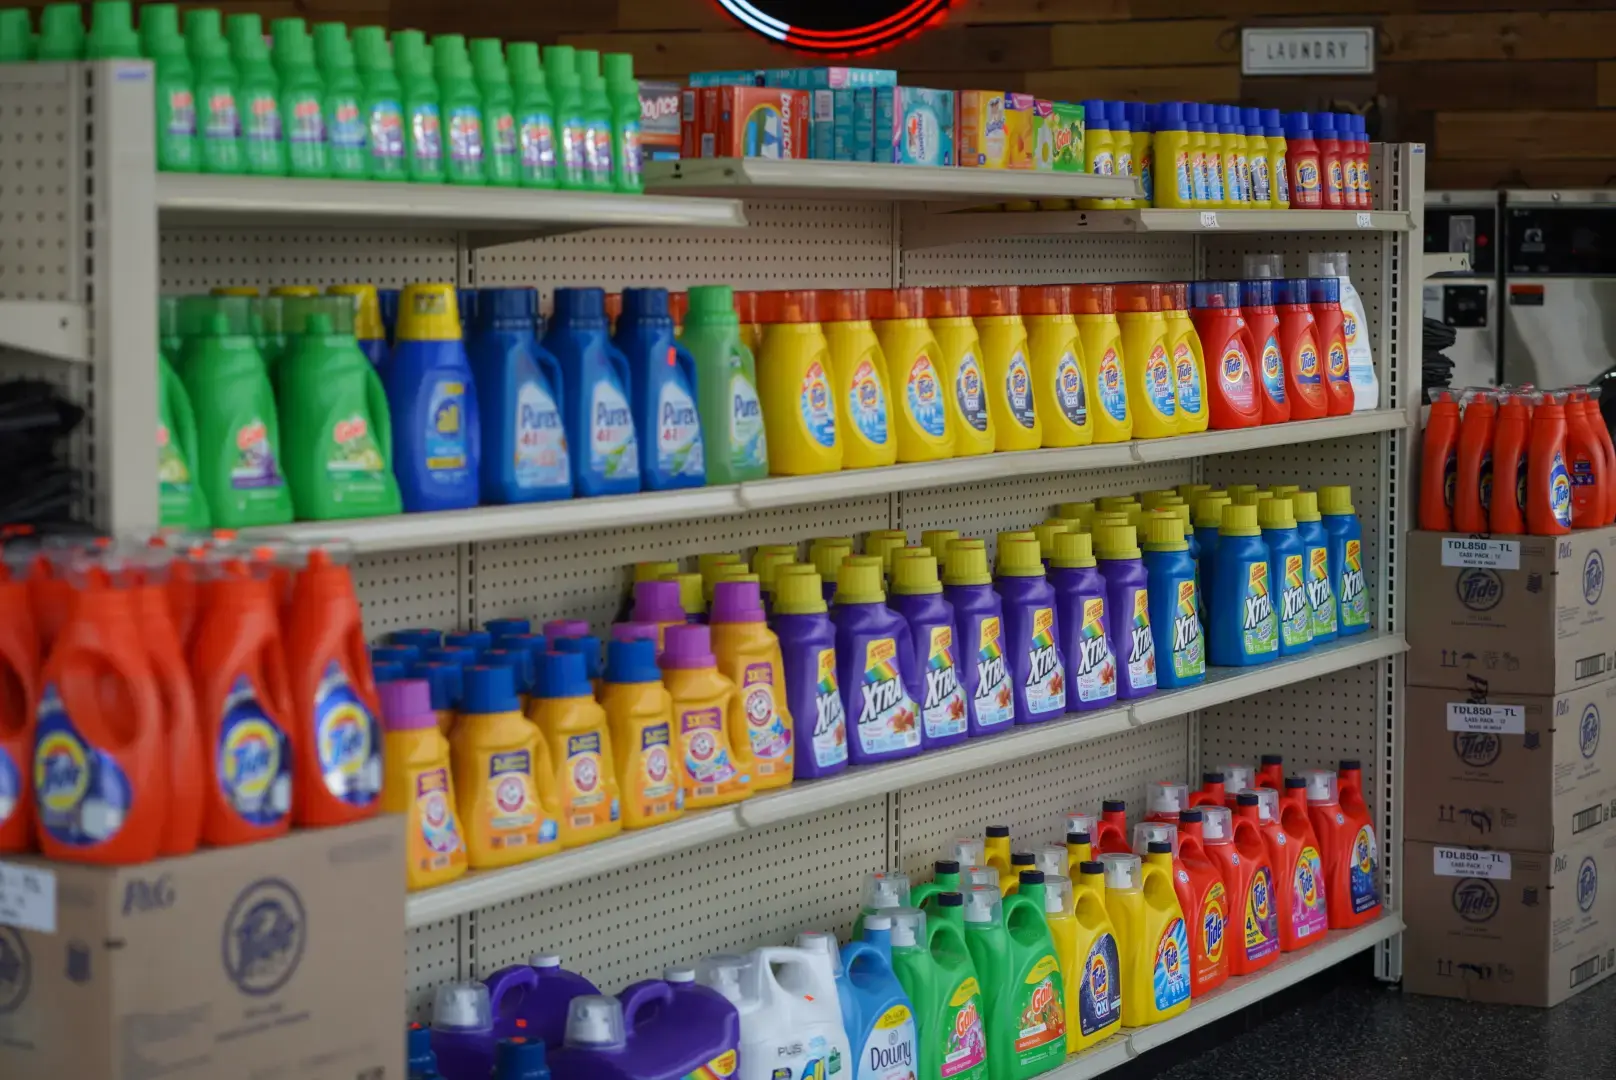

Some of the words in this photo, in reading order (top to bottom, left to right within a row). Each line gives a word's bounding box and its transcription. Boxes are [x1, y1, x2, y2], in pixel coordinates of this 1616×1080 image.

[1266, 41, 1348, 60] LAUNDRY
[1299, 166, 1317, 184] Tide
[1177, 364, 1192, 381] Tide
[1224, 359, 1241, 377] Tide
[1265, 355, 1278, 373] Tide
[1300, 352, 1316, 371] Tide
[1329, 351, 1344, 370] Tide
[1063, 373, 1078, 391] Tide
[1105, 369, 1118, 387] Tide
[1154, 366, 1167, 383] Tide
[663, 401, 696, 426] Purex
[1552, 485, 1569, 510] Tide
[1448, 540, 1487, 551] TDL850
[1499, 543, 1512, 552] TL
[1463, 578, 1499, 602] Tide
[1244, 592, 1271, 630] XTRA
[1282, 583, 1307, 622] XTRA
[1026, 643, 1058, 687] XTRA
[1077, 632, 1108, 676] XTRA
[923, 664, 958, 711] XTRA
[858, 675, 904, 725] XTRA
[1453, 705, 1492, 716] TDL850
[1504, 708, 1517, 717] TL
[1357, 841, 1368, 863] Tide
[1439, 850, 1479, 861] TDL850
[1491, 853, 1504, 863] TL
[1299, 870, 1313, 900] Tide
[1254, 882, 1266, 914] Tide
[1458, 889, 1495, 913] Tide
[1204, 914, 1222, 956] Tide
[1164, 948, 1178, 974] Tide
[1092, 965, 1107, 997] Tide
[1031, 981, 1053, 1014] Gain
[1096, 1000, 1109, 1017] OXI
[956, 1004, 977, 1039] Gain
[871, 1040, 912, 1072] Downy
